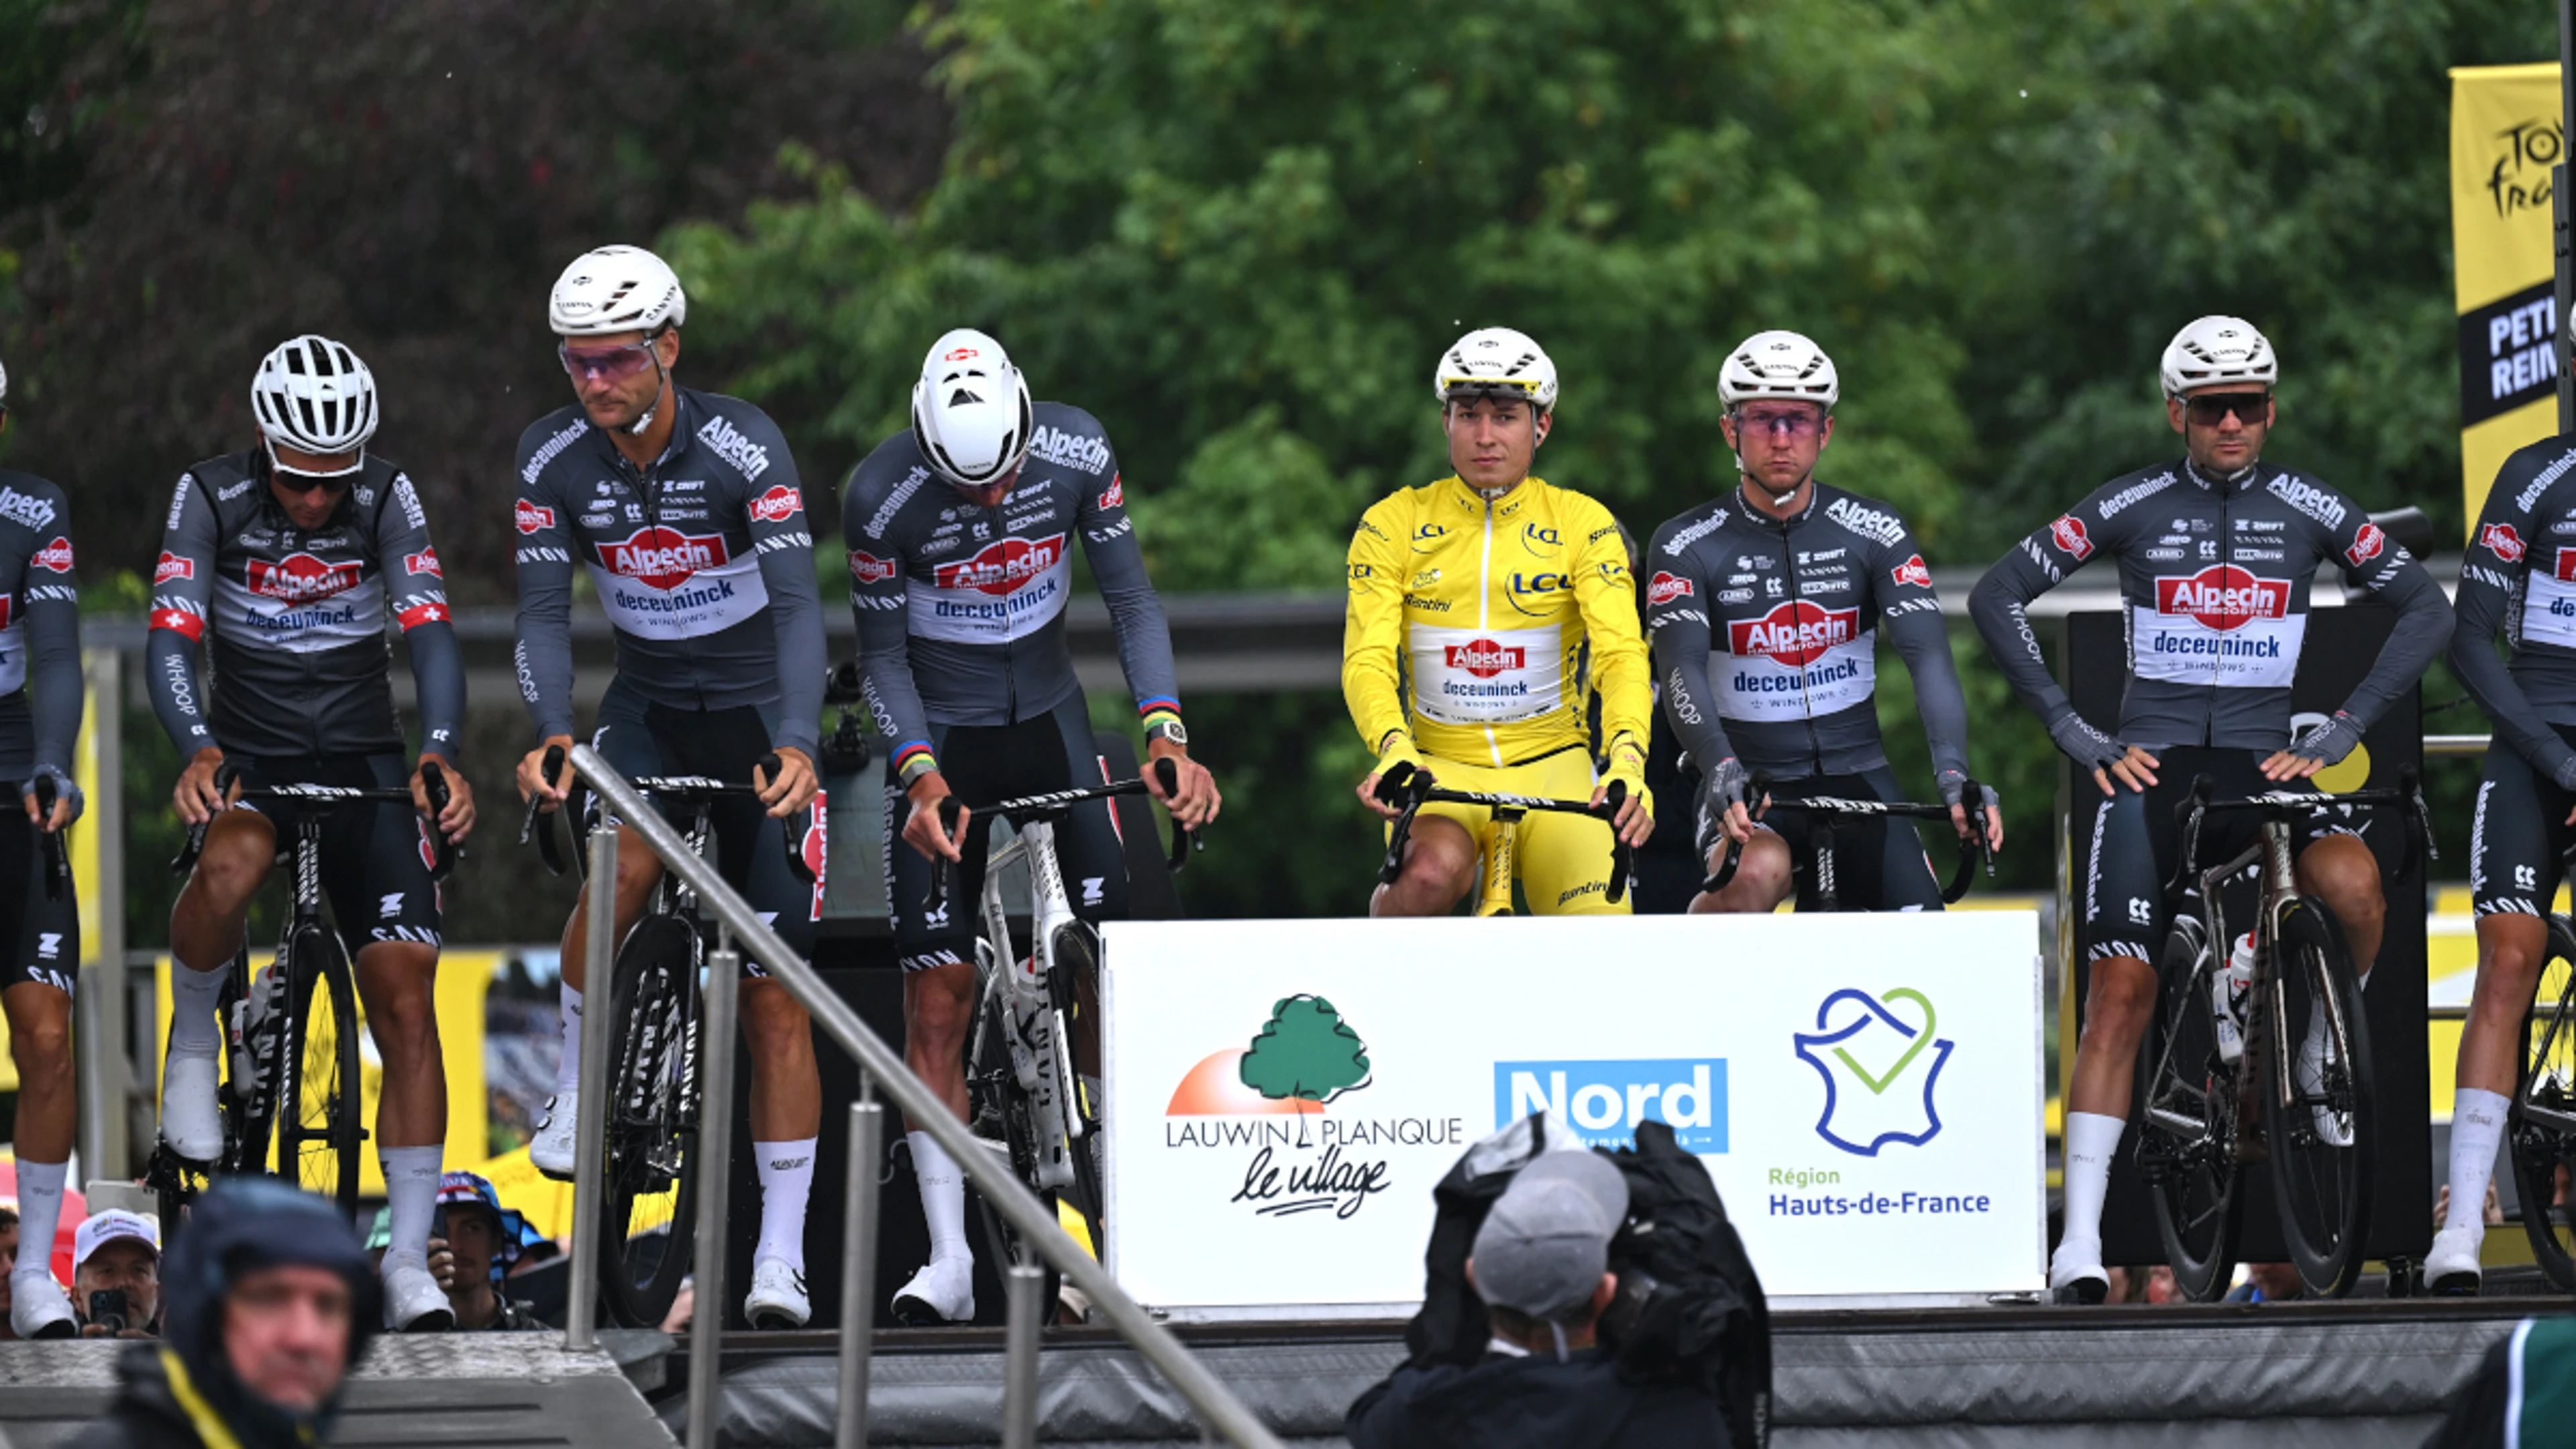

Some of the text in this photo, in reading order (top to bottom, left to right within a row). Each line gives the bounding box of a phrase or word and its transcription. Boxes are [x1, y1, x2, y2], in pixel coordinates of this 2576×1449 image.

[521, 417, 589, 484] deceuninck
[702, 415, 770, 478] Alpecin
[1030, 425, 1110, 471] Alpecin
[862, 464, 932, 540] deceuninck
[2098, 471, 2178, 521] deceuninck
[2267, 472, 2347, 523] Alpecin
[1527, 523, 1564, 546] LCL
[1662, 508, 1730, 557] deceuninck
[1826, 497, 1907, 544] Alpecin
[615, 543, 712, 577] Alpecin
[953, 545, 1054, 588] Alpecin
[614, 580, 735, 612] deceuninck
[934, 576, 1058, 619] deceuninck
[1513, 573, 1573, 594] LCL
[2172, 581, 2277, 614] Alpecin
[1748, 616, 1847, 653] Alpecin
[2008, 602, 2045, 665] WHOOP
[2154, 631, 2281, 658] deceuninck
[1452, 647, 1517, 668] Alpecin
[1733, 657, 1859, 693] deceuninck
[861, 676, 900, 739] WHOOP
[1443, 680, 1528, 697] deceuninck
[1668, 667, 1703, 726] WHOOP
[1511, 1065, 1712, 1131] Nord
[1165, 1117, 1463, 1148] LAUWIN PLANQUE
[1230, 1142, 1392, 1220] le village
[1768, 1167, 1841, 1190] Région
[1769, 1191, 1990, 1216] Hauts-de-France
